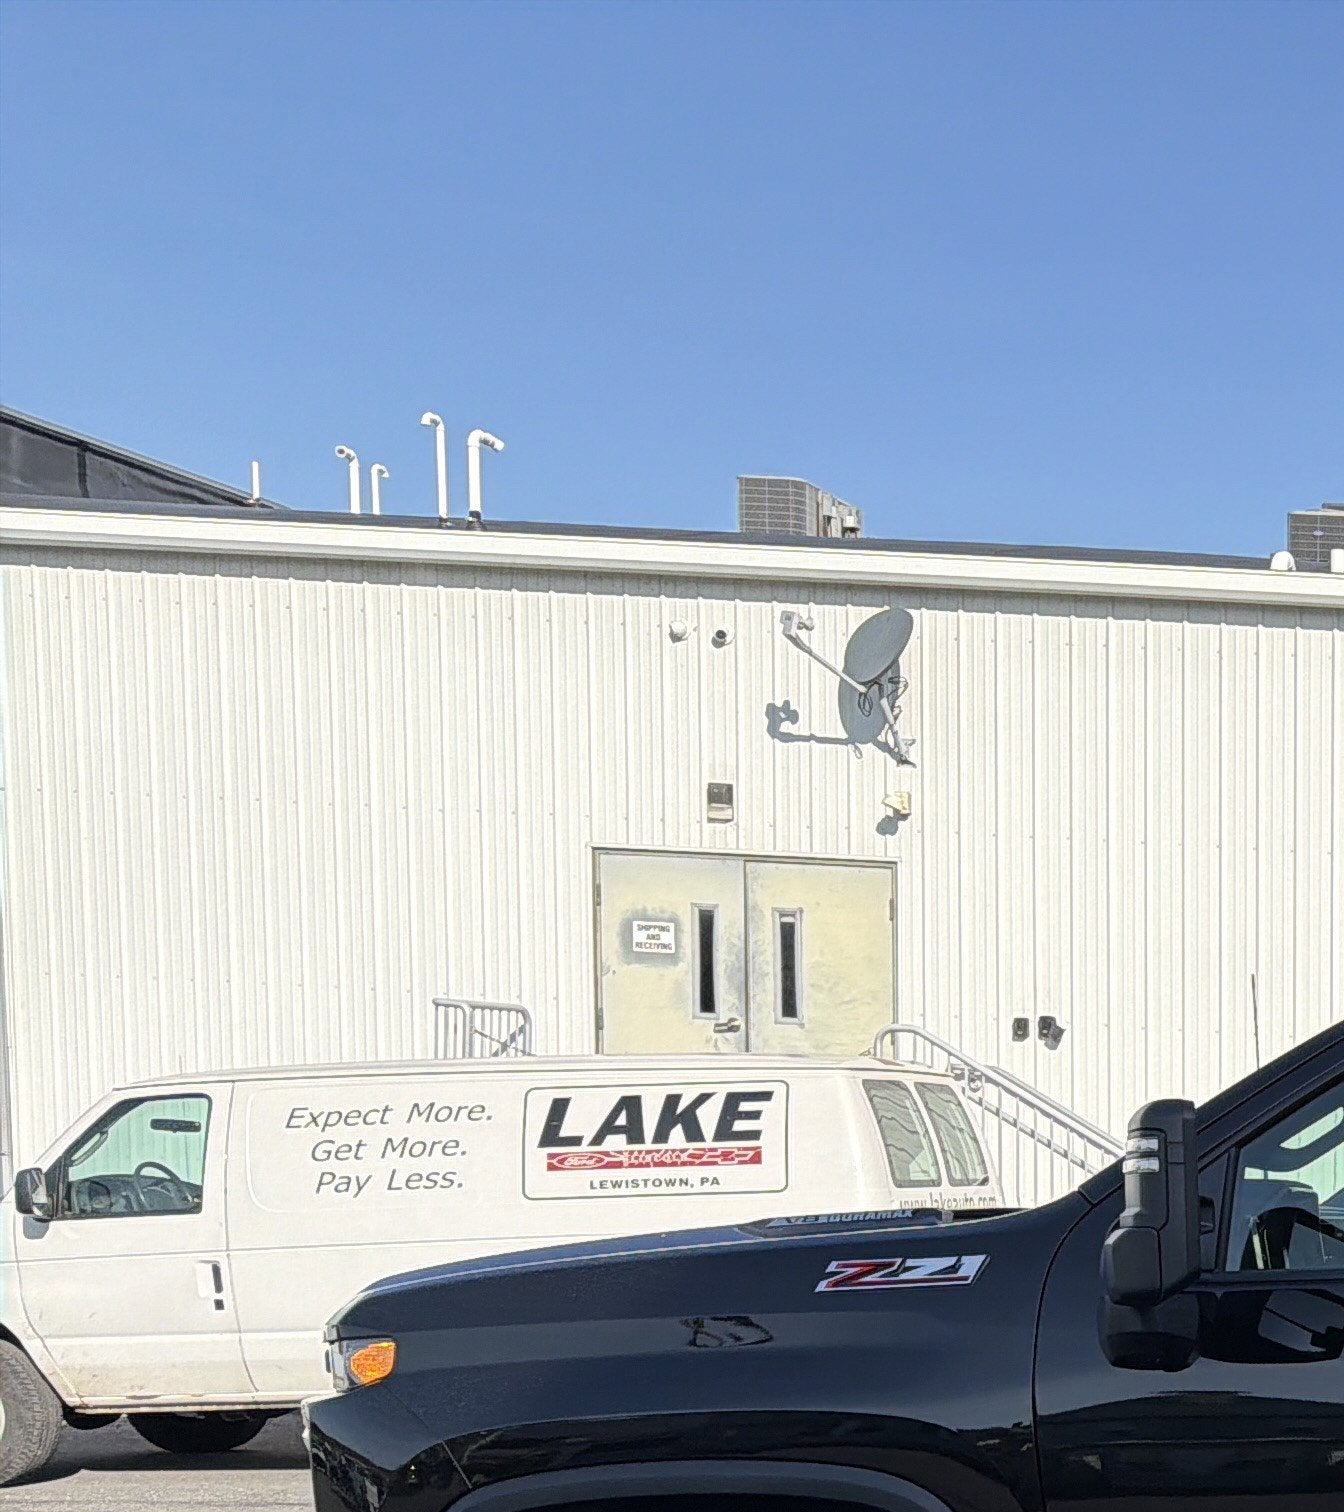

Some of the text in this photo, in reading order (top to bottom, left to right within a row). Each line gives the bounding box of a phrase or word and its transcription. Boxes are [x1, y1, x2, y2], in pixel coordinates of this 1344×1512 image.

[634, 942, 673, 950] RECEIVING
[284, 1101, 493, 1133] Expect More.
[536, 1090, 775, 1149] LAKE
[310, 1136, 467, 1162] Get More.
[315, 1168, 463, 1199] Pay Less.
[589, 1175, 721, 1191] LEWISTOWN, PA
